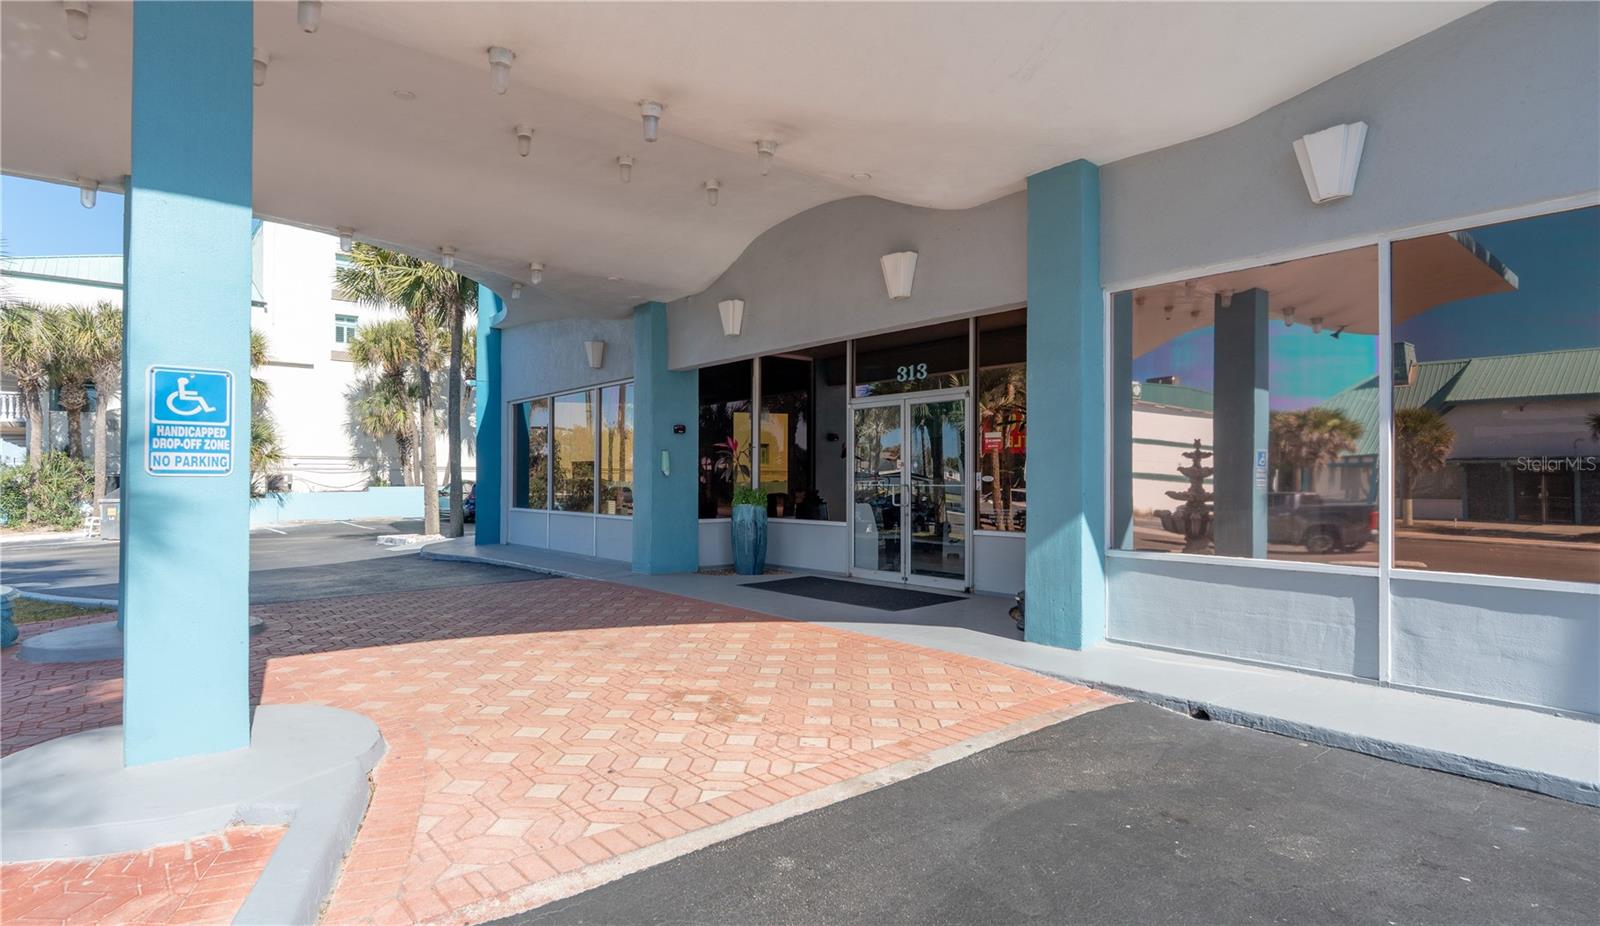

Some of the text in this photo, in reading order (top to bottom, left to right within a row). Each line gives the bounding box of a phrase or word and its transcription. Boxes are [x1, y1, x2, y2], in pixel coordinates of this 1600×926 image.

[896, 363, 928, 382] 313
[156, 425, 227, 438] HANDICAPPED
[152, 438, 230, 451] DROP-OFF ZONE
[152, 455, 227, 468] NO PARKING
